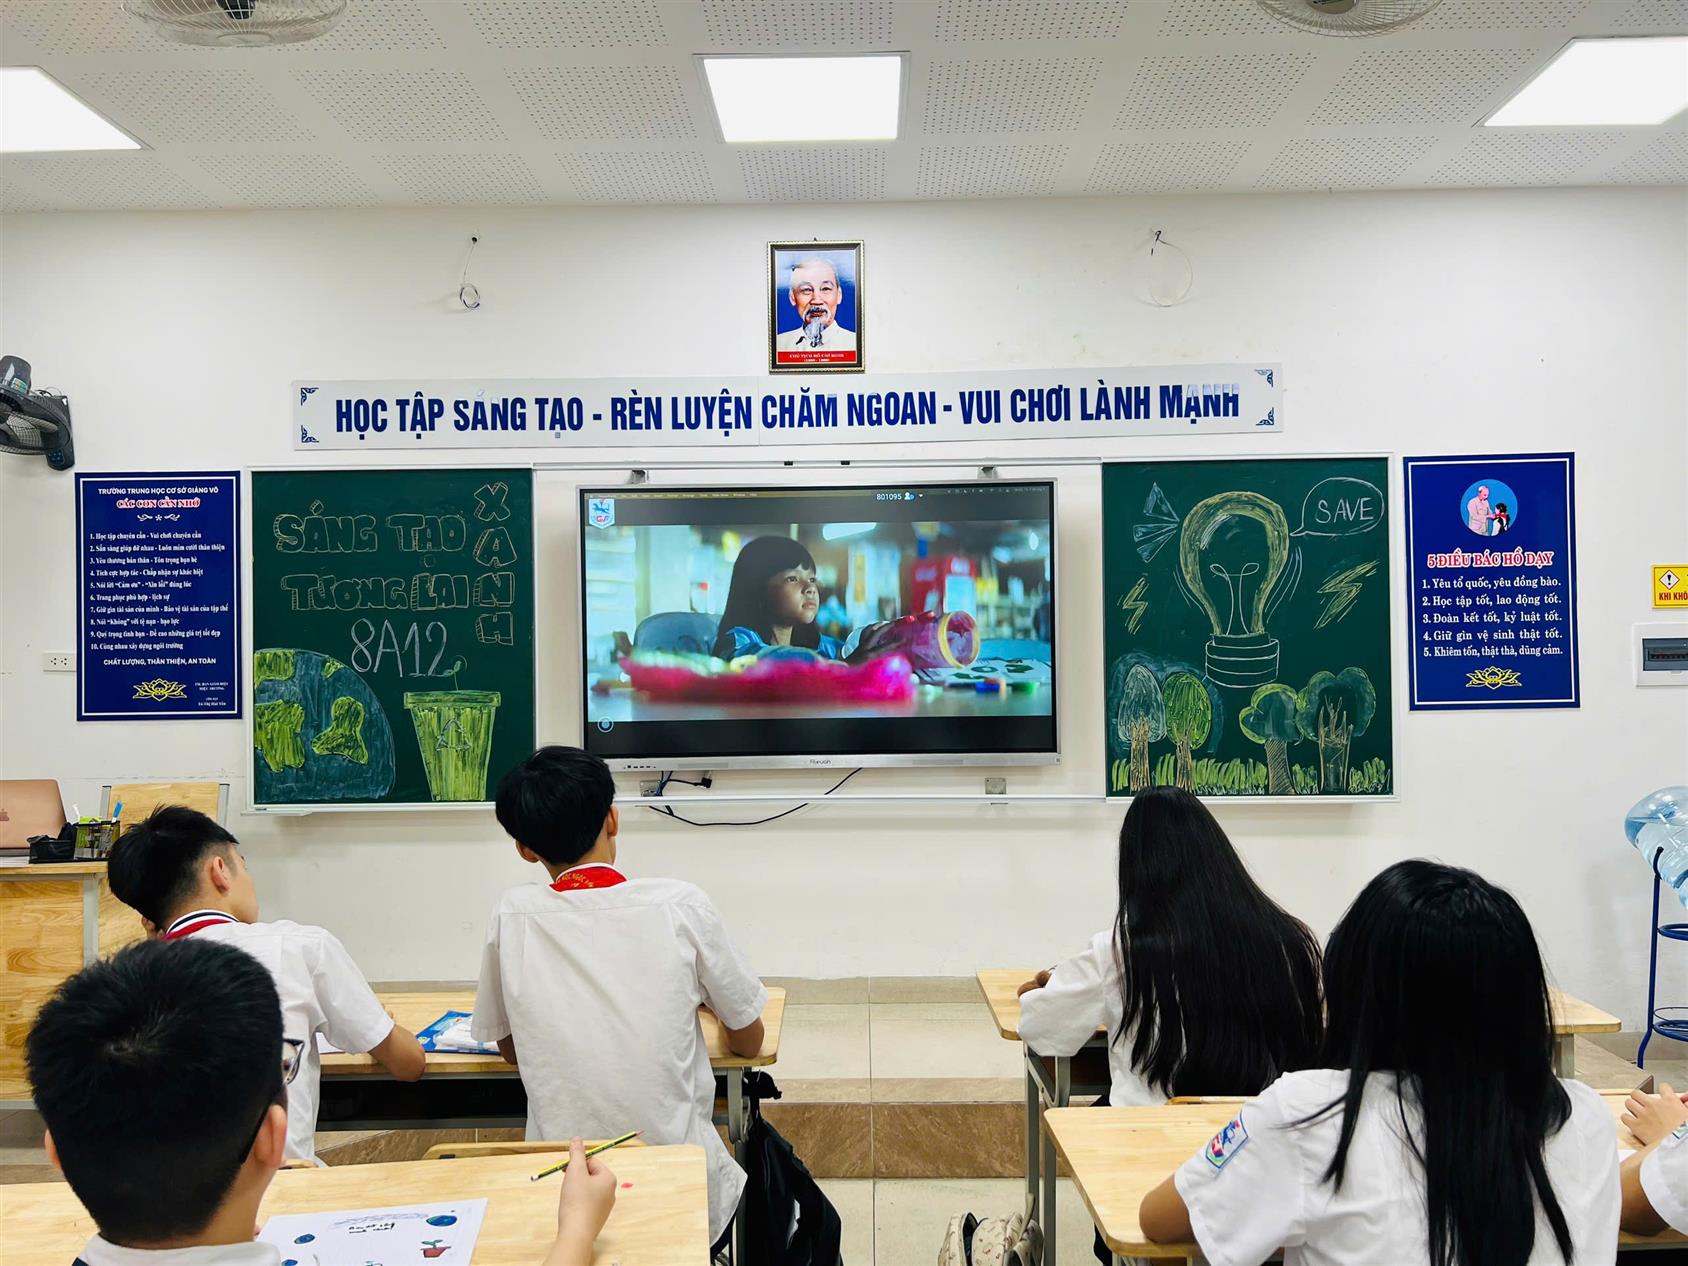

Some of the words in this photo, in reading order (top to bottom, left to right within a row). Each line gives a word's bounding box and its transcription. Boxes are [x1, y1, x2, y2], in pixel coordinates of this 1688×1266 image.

[336, 399, 388, 440] HỌC
[396, 391, 444, 439] TẬP
[454, 389, 526, 431] SÁNG
[535, 397, 583, 438] TẠO
[611, 390, 662, 430] RÈN
[671, 388, 751, 436] LUYỆN
[761, 387, 838, 428] CHĂM
[847, 391, 936, 428] NGOAN
[959, 390, 1001, 424] VUI
[1011, 384, 1071, 422] CHƠI
[1080, 379, 1150, 420] LÀNH
[1159, 384, 1239, 424] MẠNH
[1315, 497, 1375, 523] SAVE
[274, 499, 378, 553] SÁNG
[1427, 554, 1436, 568] 5
[1437, 547, 1471, 568] ĐIỀU
[1473, 549, 1500, 567] BÁC
[1502, 546, 1523, 567] HỒ
[1525, 551, 1554, 569] DẠY
[411, 572, 469, 611] LAI
[1422, 580, 1430, 588] 1.
[1432, 578, 1451, 588] Yêu
[1453, 576, 1463, 588] tổ
[1466, 576, 1491, 589] quốc,
[1493, 577, 1511, 589] yêu
[1513, 575, 1538, 589] đồng
[1540, 576, 1561, 587] bào.
[1422, 597, 1430, 606] 2.
[1433, 596, 1452, 608] Học
[1456, 596, 1472, 608] tập
[1476, 593, 1493, 606] tốt,
[1496, 595, 1512, 604] lao
[1515, 594, 1540, 607] động
[1544, 592, 1562, 604] tốt.
[1659, 592, 1671, 600] KHI
[1423, 614, 1431, 623] 3.
[1433, 613, 1459, 623] Đoàn
[1463, 612, 1479, 623] kết
[1483, 611, 1500, 623] tốt,
[1504, 611, 1516, 623] kỷ
[1521, 612, 1540, 623] luật
[1545, 609, 1562, 621] tốt.
[1423, 631, 1431, 640] 4.
[1434, 630, 1452, 640] Giữ
[1456, 630, 1472, 642] gìn
[1477, 630, 1488, 642] vệ
[1493, 629, 1515, 639] sinh
[1520, 629, 1540, 641] thật
[1545, 627, 1562, 638] tốt.
[350, 618, 449, 677] 8A12
[1424, 647, 1431, 657] 5.
[1434, 647, 1462, 657] Khiêm
[1463, 645, 1480, 657] tốn,
[1482, 646, 1499, 658] thật
[1501, 645, 1517, 657] thà,
[1519, 645, 1541, 657] dũng
[1543, 644, 1563, 655] cảm.
